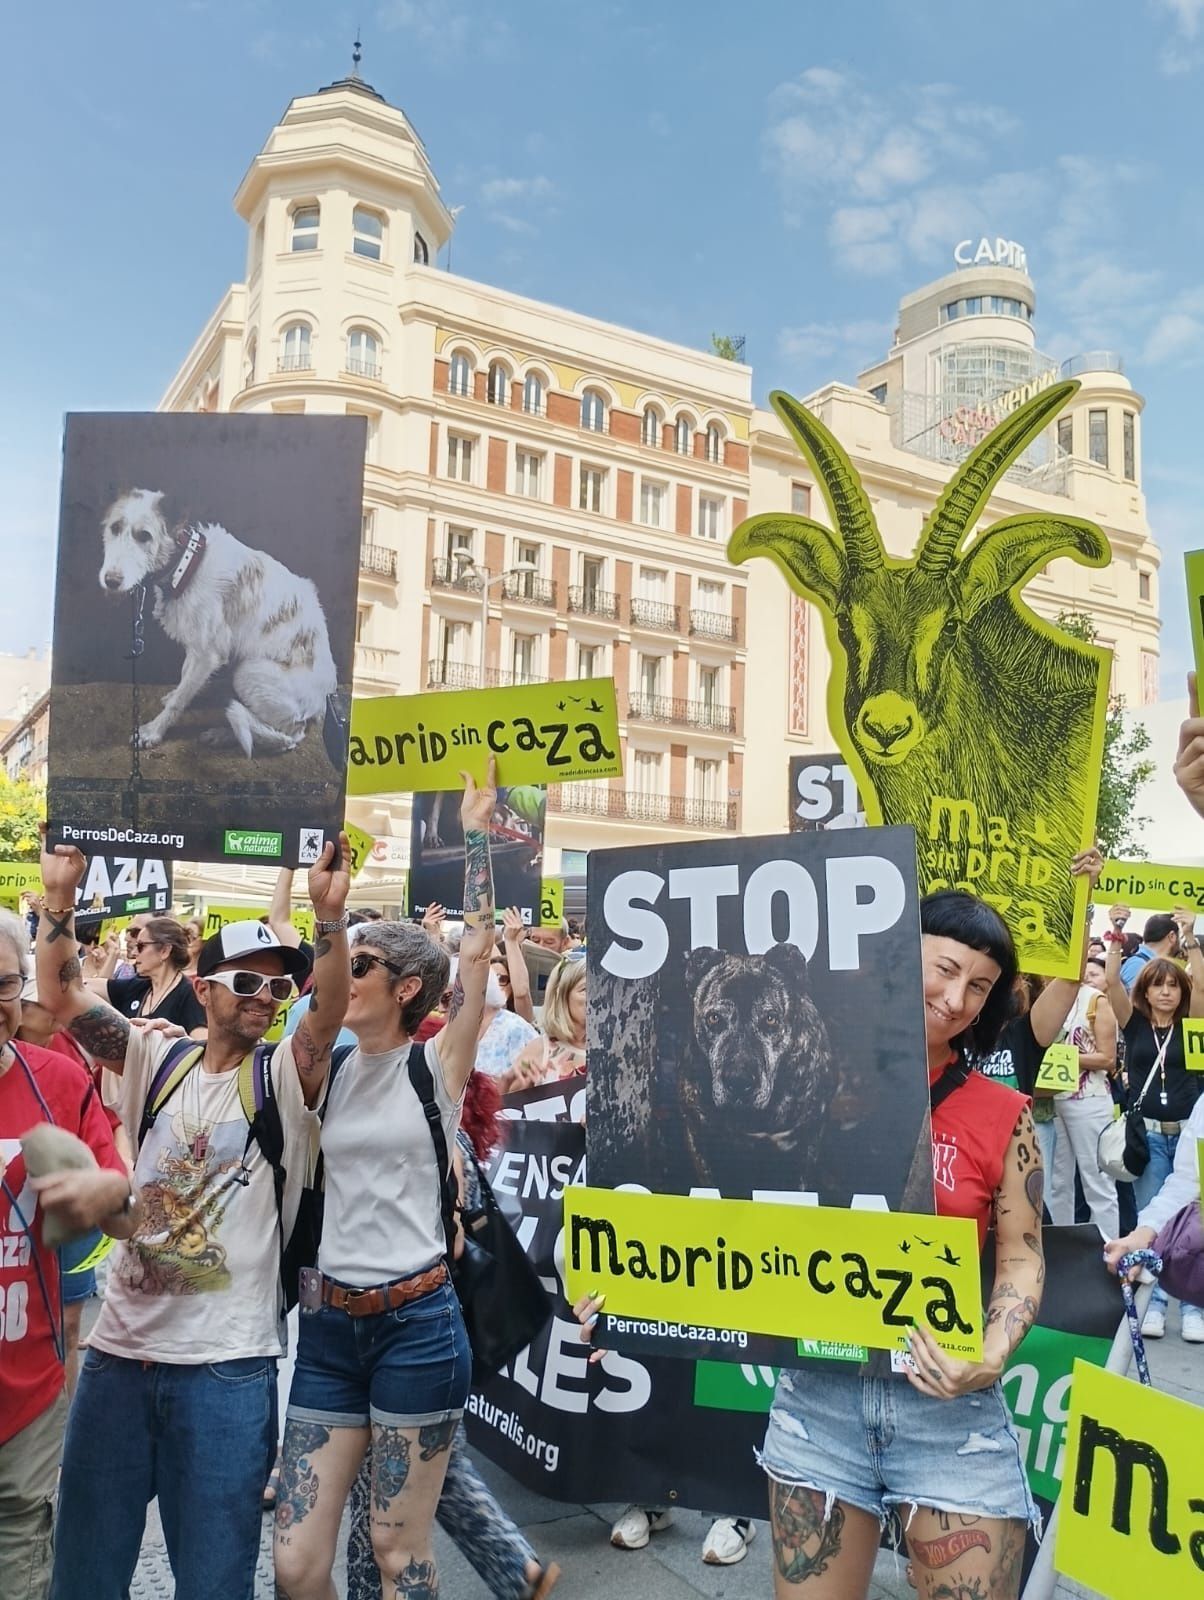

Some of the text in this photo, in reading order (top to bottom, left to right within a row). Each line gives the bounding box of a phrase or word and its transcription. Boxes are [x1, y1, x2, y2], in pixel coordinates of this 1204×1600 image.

[349, 717, 616, 767] aDriD sin caza
[796, 764, 858, 820] ST
[62, 826, 184, 849] PerrosDeCaza.org
[75, 855, 169, 906] AZA
[1148, 878, 1166, 890] sin
[600, 855, 906, 980] STOP
[760, 1246, 800, 1277] sin
[807, 1250, 974, 1335] caza
[606, 1315, 748, 1349] PerrosDeCaza.org
[464, 1394, 560, 1472] aturalis.org
